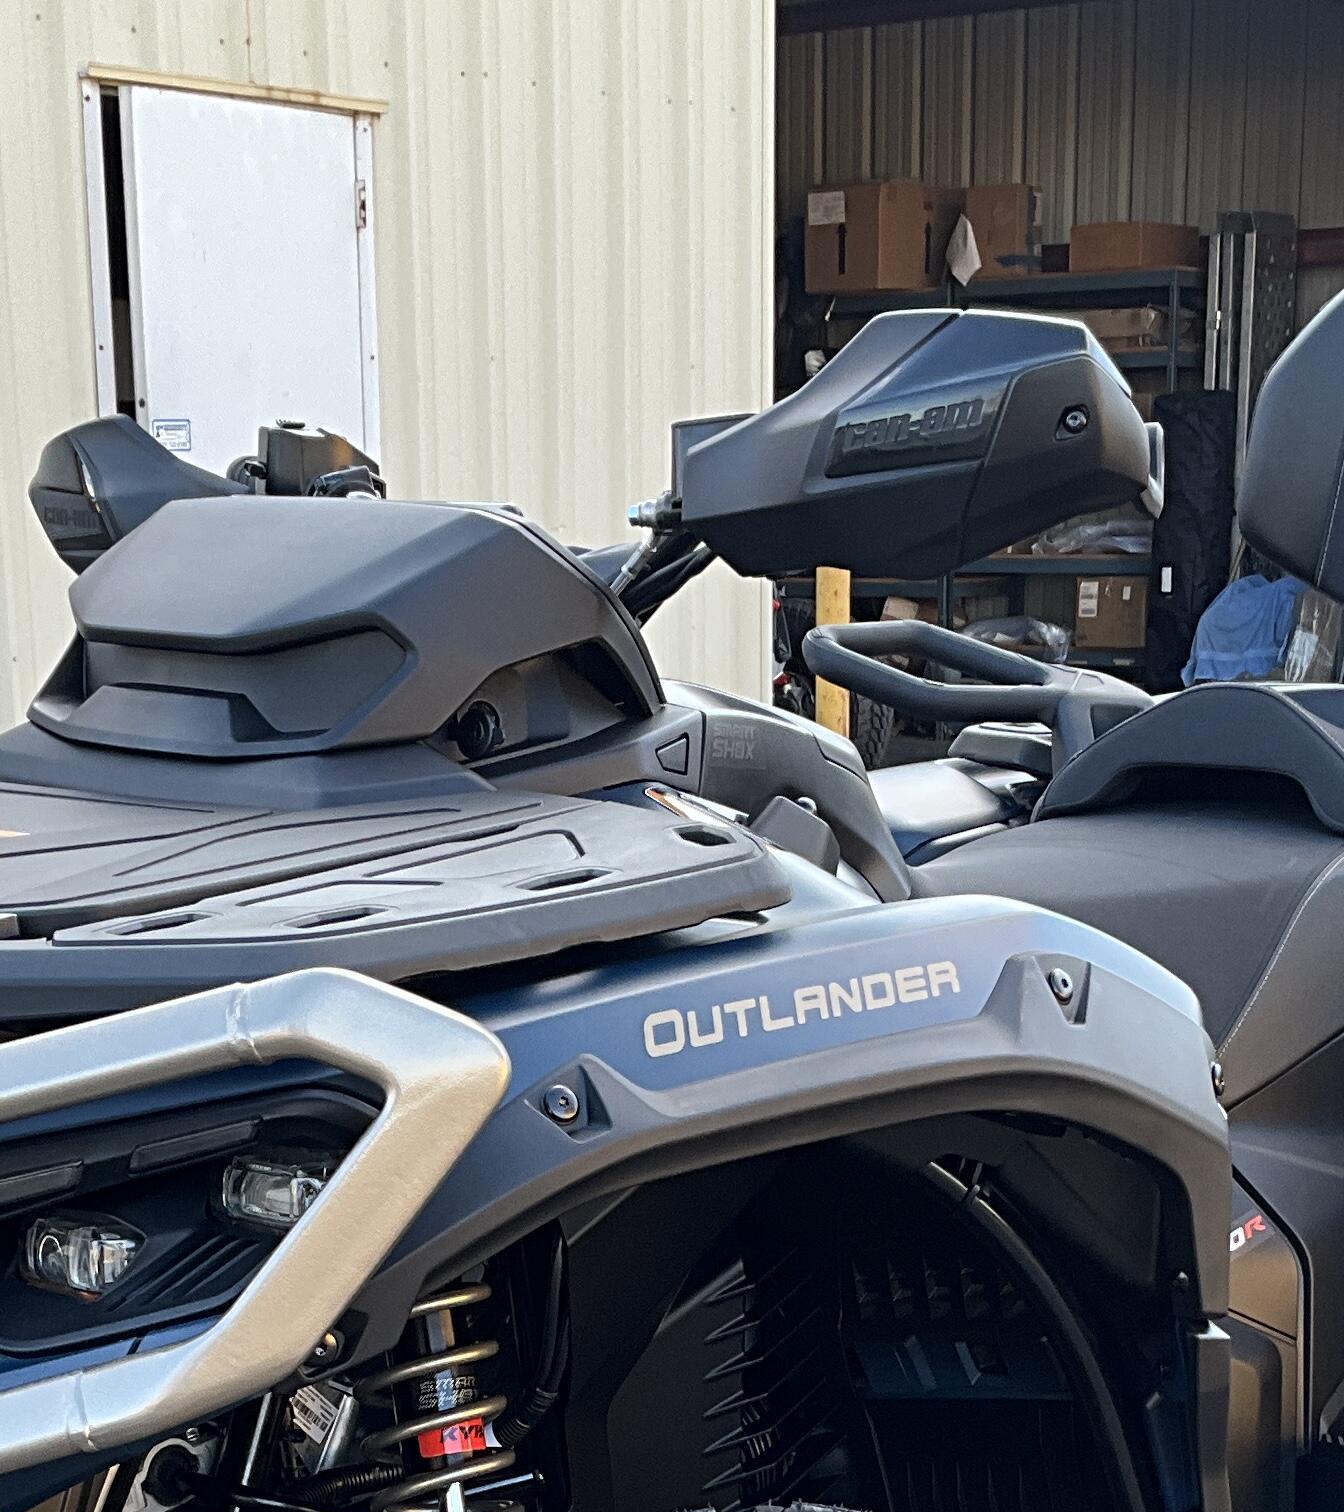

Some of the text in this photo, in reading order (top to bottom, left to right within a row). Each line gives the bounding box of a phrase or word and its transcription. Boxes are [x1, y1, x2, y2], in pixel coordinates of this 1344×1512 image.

[840, 400, 985, 453] can-am
[712, 739, 754, 759] SHOX
[643, 960, 960, 1058] OUTLANDER
